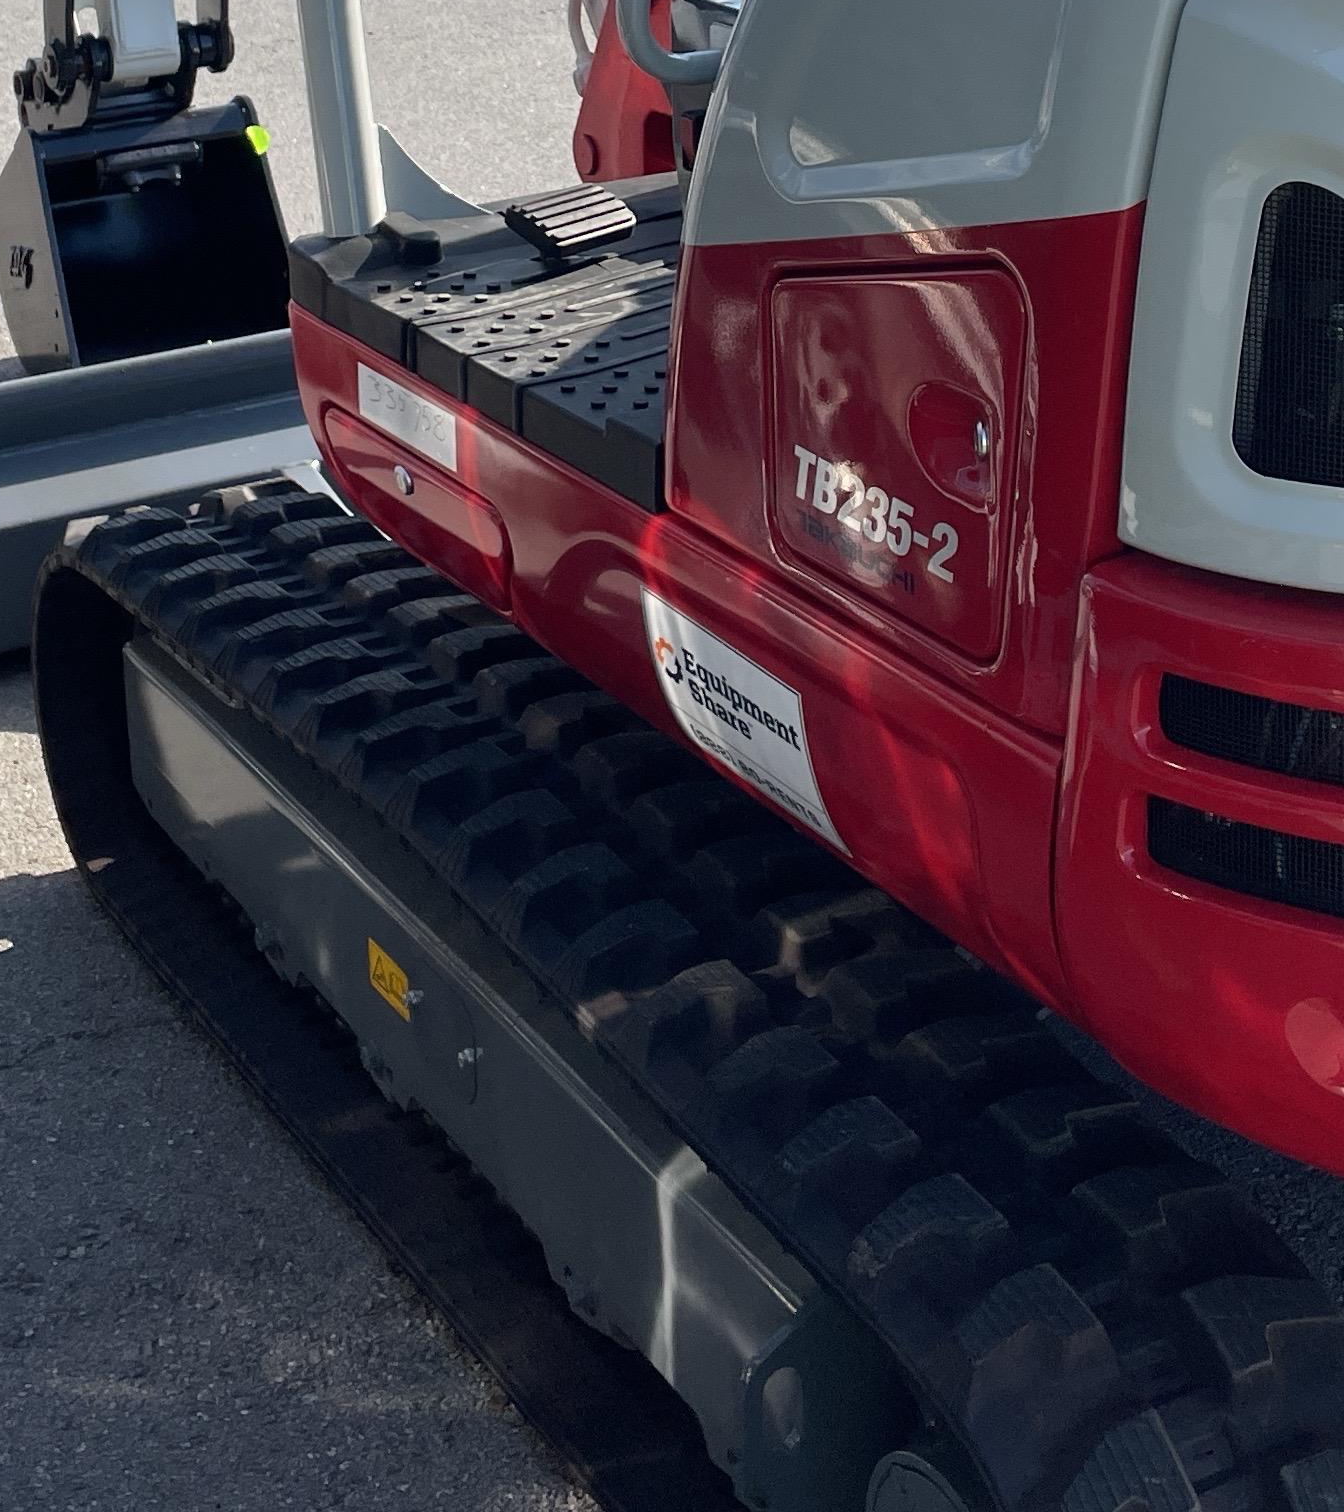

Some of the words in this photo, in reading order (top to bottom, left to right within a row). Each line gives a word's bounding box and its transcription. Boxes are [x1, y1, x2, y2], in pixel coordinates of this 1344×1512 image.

[794, 444, 959, 584] TB235-2
[682, 647, 801, 752] Equipment
[688, 678, 753, 740] Share
